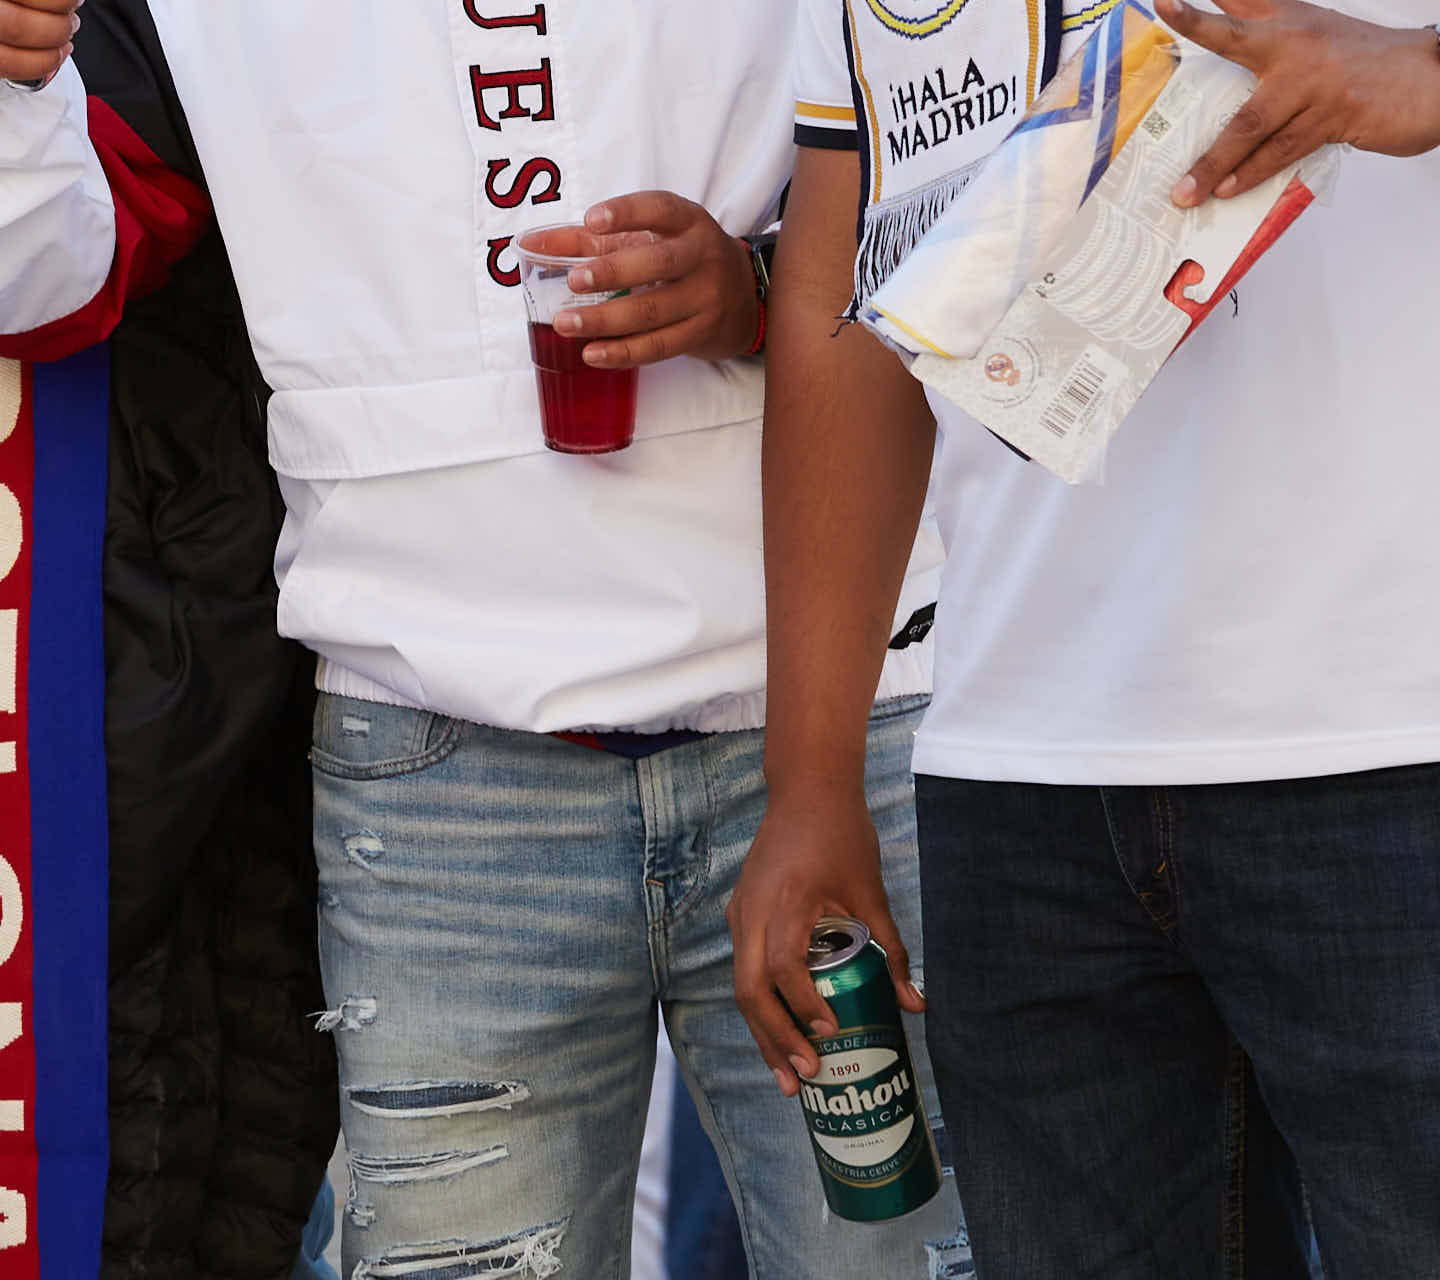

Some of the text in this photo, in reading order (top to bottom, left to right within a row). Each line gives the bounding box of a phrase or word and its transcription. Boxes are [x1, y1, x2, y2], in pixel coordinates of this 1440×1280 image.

[889, 57, 985, 123] ¡HALA
[887, 75, 1016, 166] MADRID!
[801, 1069, 911, 1117] Mahou
[829, 1062, 861, 1077] 1890
[815, 1104, 904, 1133] CLÁSICA
